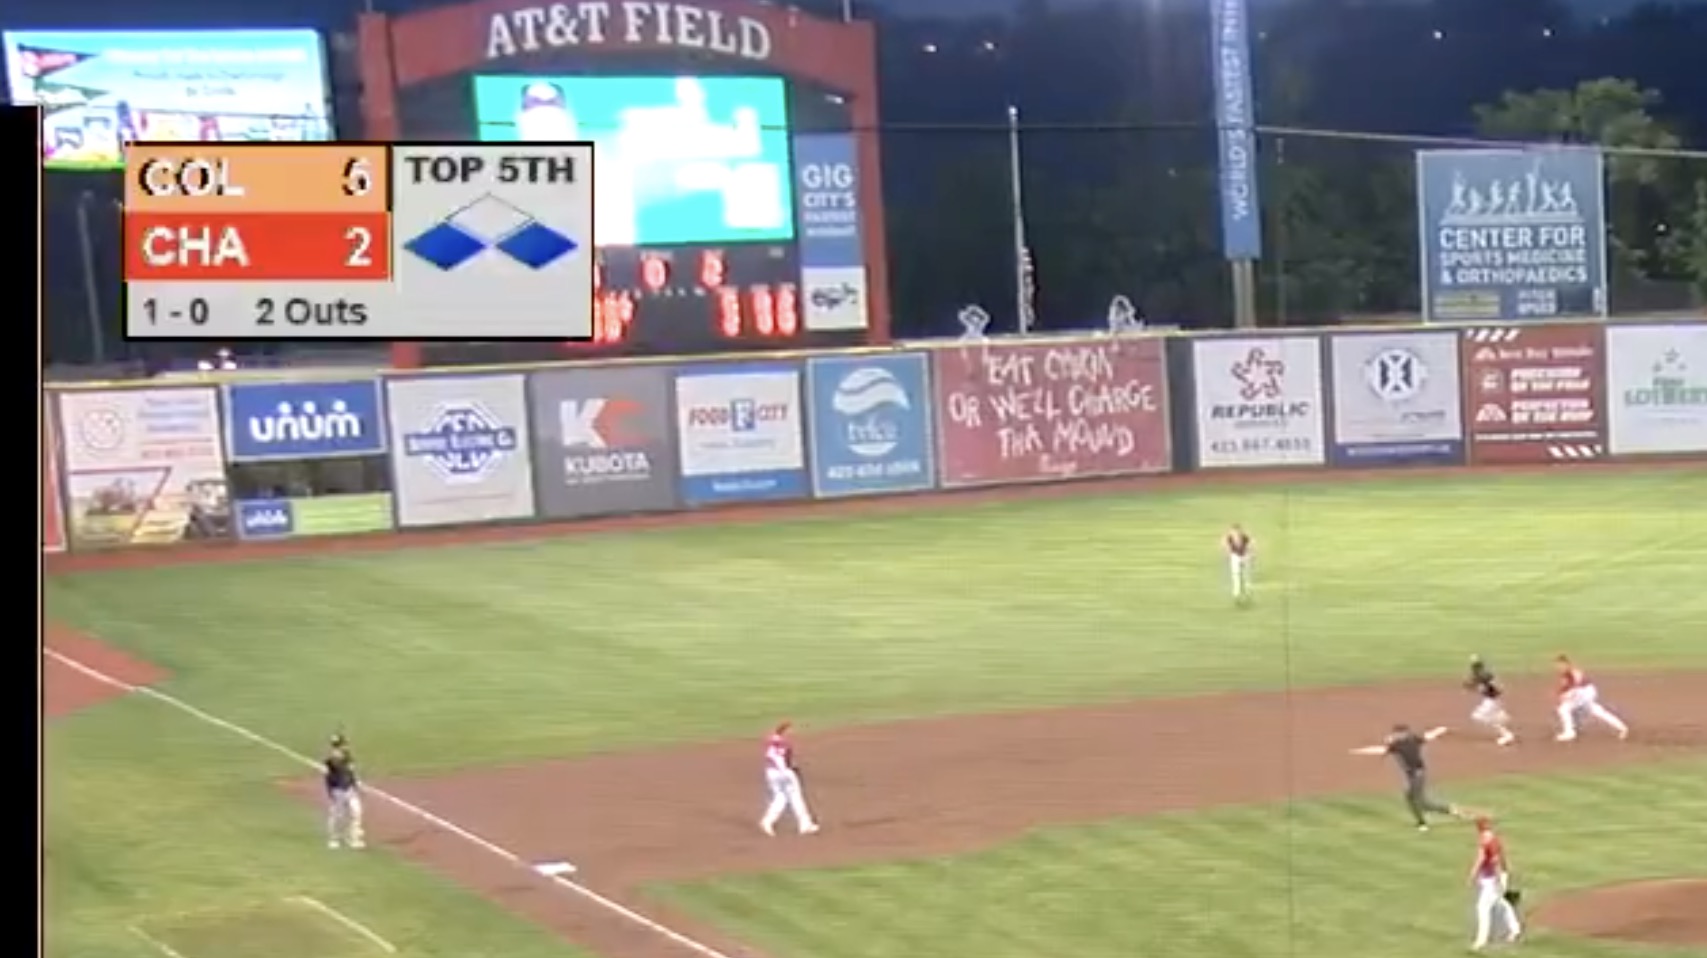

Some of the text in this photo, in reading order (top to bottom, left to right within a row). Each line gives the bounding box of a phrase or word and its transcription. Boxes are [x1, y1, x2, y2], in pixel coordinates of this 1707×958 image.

[487, 1, 772, 60] AT&T FIELD
[802, 163, 853, 189] GIG
[1440, 225, 1587, 250] CENTER FOR
[1440, 249, 1587, 268] SPORTS MEDICINE
[1440, 265, 1588, 285] & ORTHOPAEDICS
[988, 353, 1035, 387] EAT
[688, 406, 730, 427] FOOD
[757, 402, 789, 422] CITY
[949, 391, 982, 429] OR
[1068, 378, 1157, 416] CHARGE
[1211, 401, 1310, 419] REPUBLIC
[250, 400, 361, 442] unum
[1052, 418, 1135, 457] MOUND
[564, 452, 651, 474] KUBOTA
